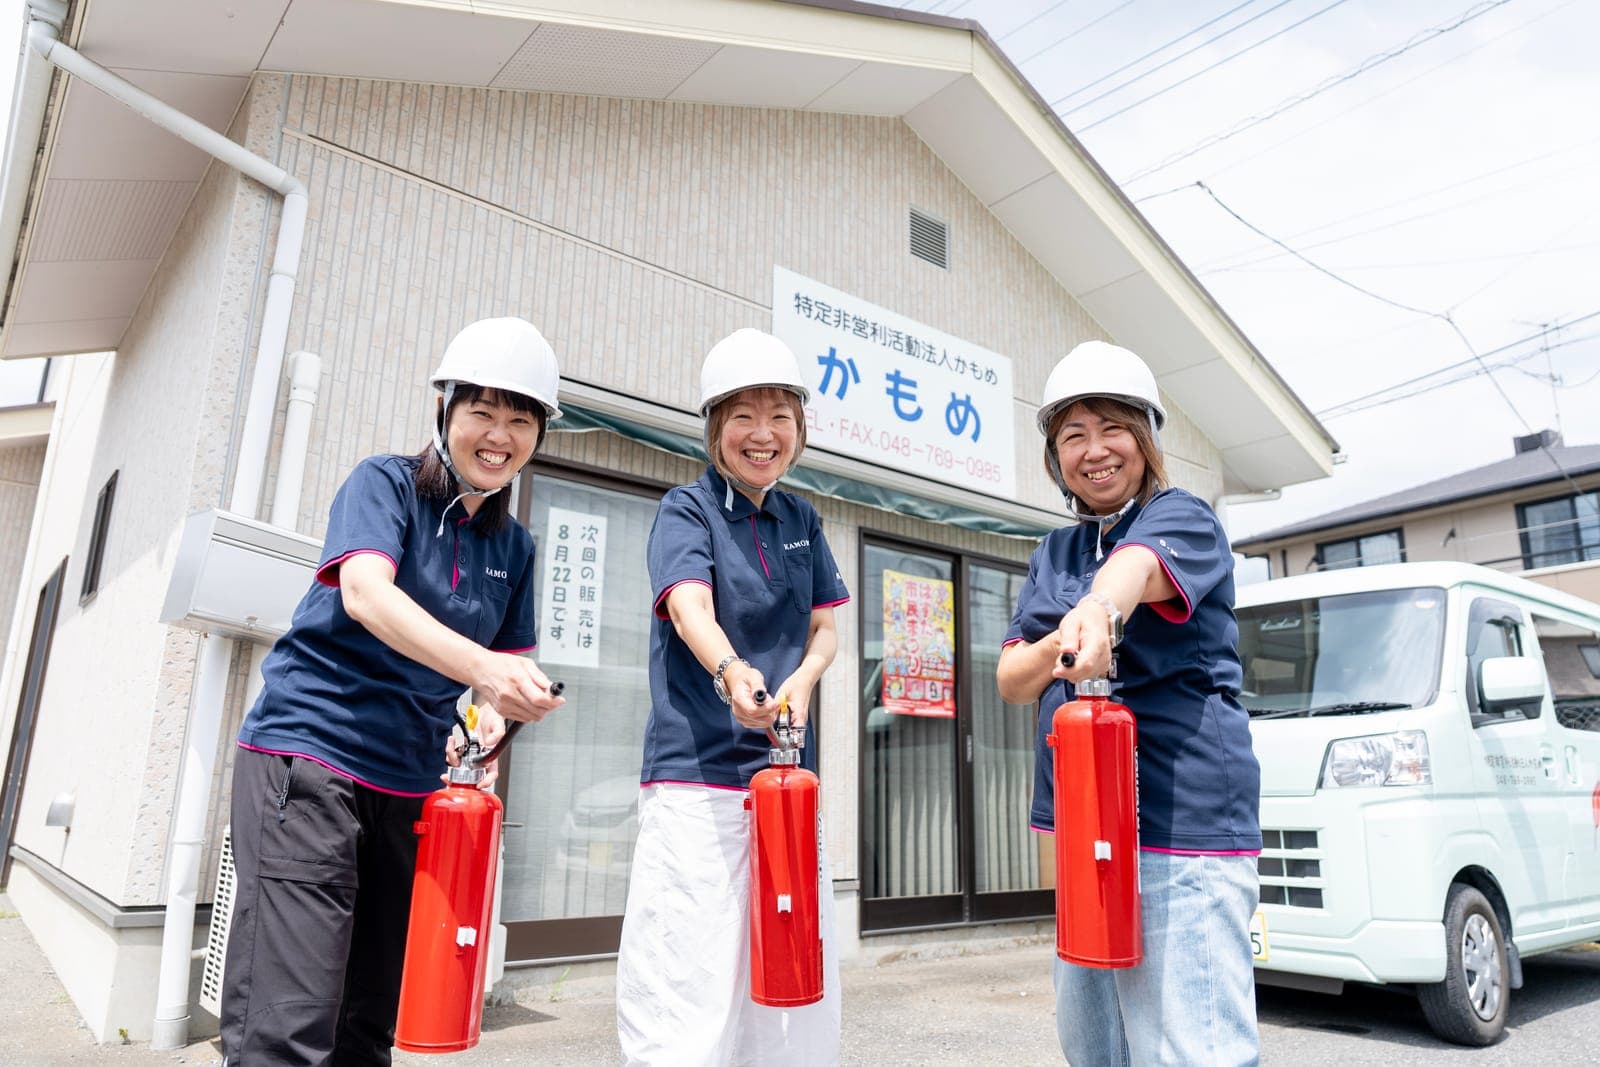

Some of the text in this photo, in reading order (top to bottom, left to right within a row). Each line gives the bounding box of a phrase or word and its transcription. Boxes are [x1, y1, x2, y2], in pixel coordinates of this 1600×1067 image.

[793, 291, 999, 386] 特定非営利活動法人かもめ
[818, 346, 981, 443] かもめ
[550, 525, 571, 648] 8月22日です。
[577, 525, 599, 648] 次回の販売は
